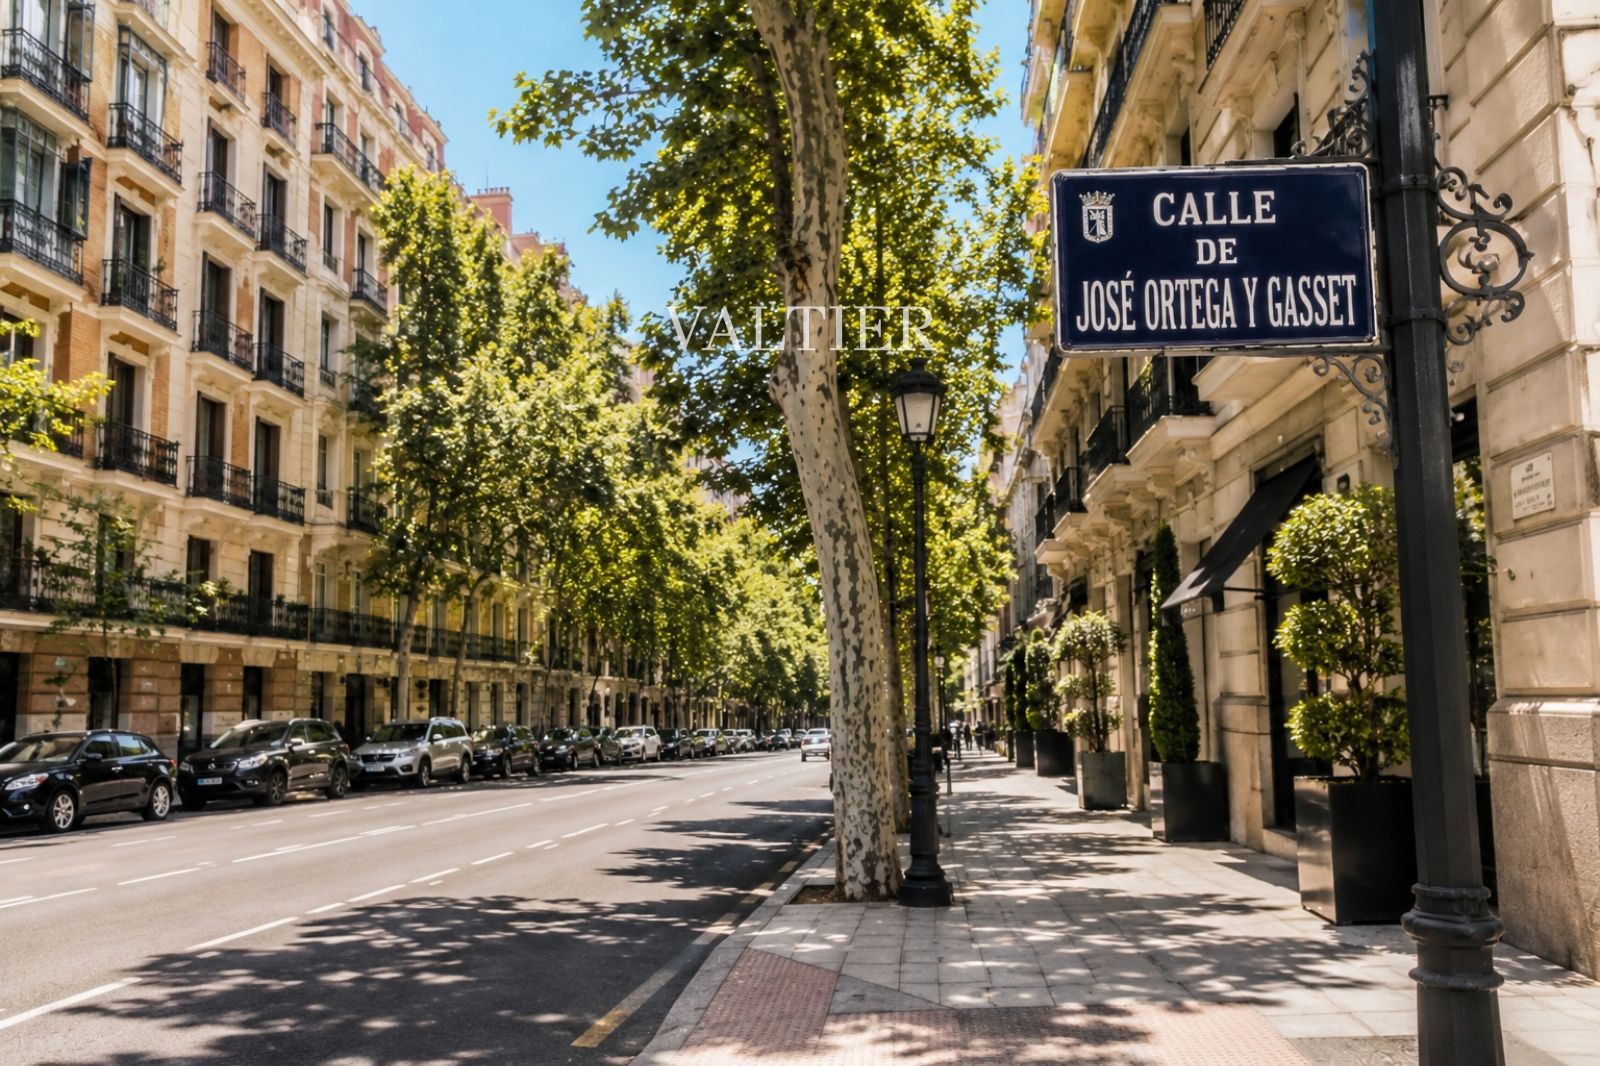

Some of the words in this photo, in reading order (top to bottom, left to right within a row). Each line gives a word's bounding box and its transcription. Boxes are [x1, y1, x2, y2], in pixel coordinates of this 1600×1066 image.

[1153, 190, 1276, 226] CALLE
[1196, 238, 1238, 265] DE
[1076, 271, 1136, 332] JOSÉ
[1144, 277, 1237, 331] ORTEGA
[1243, 277, 1258, 328] Y
[1267, 274, 1357, 328] GASSET
